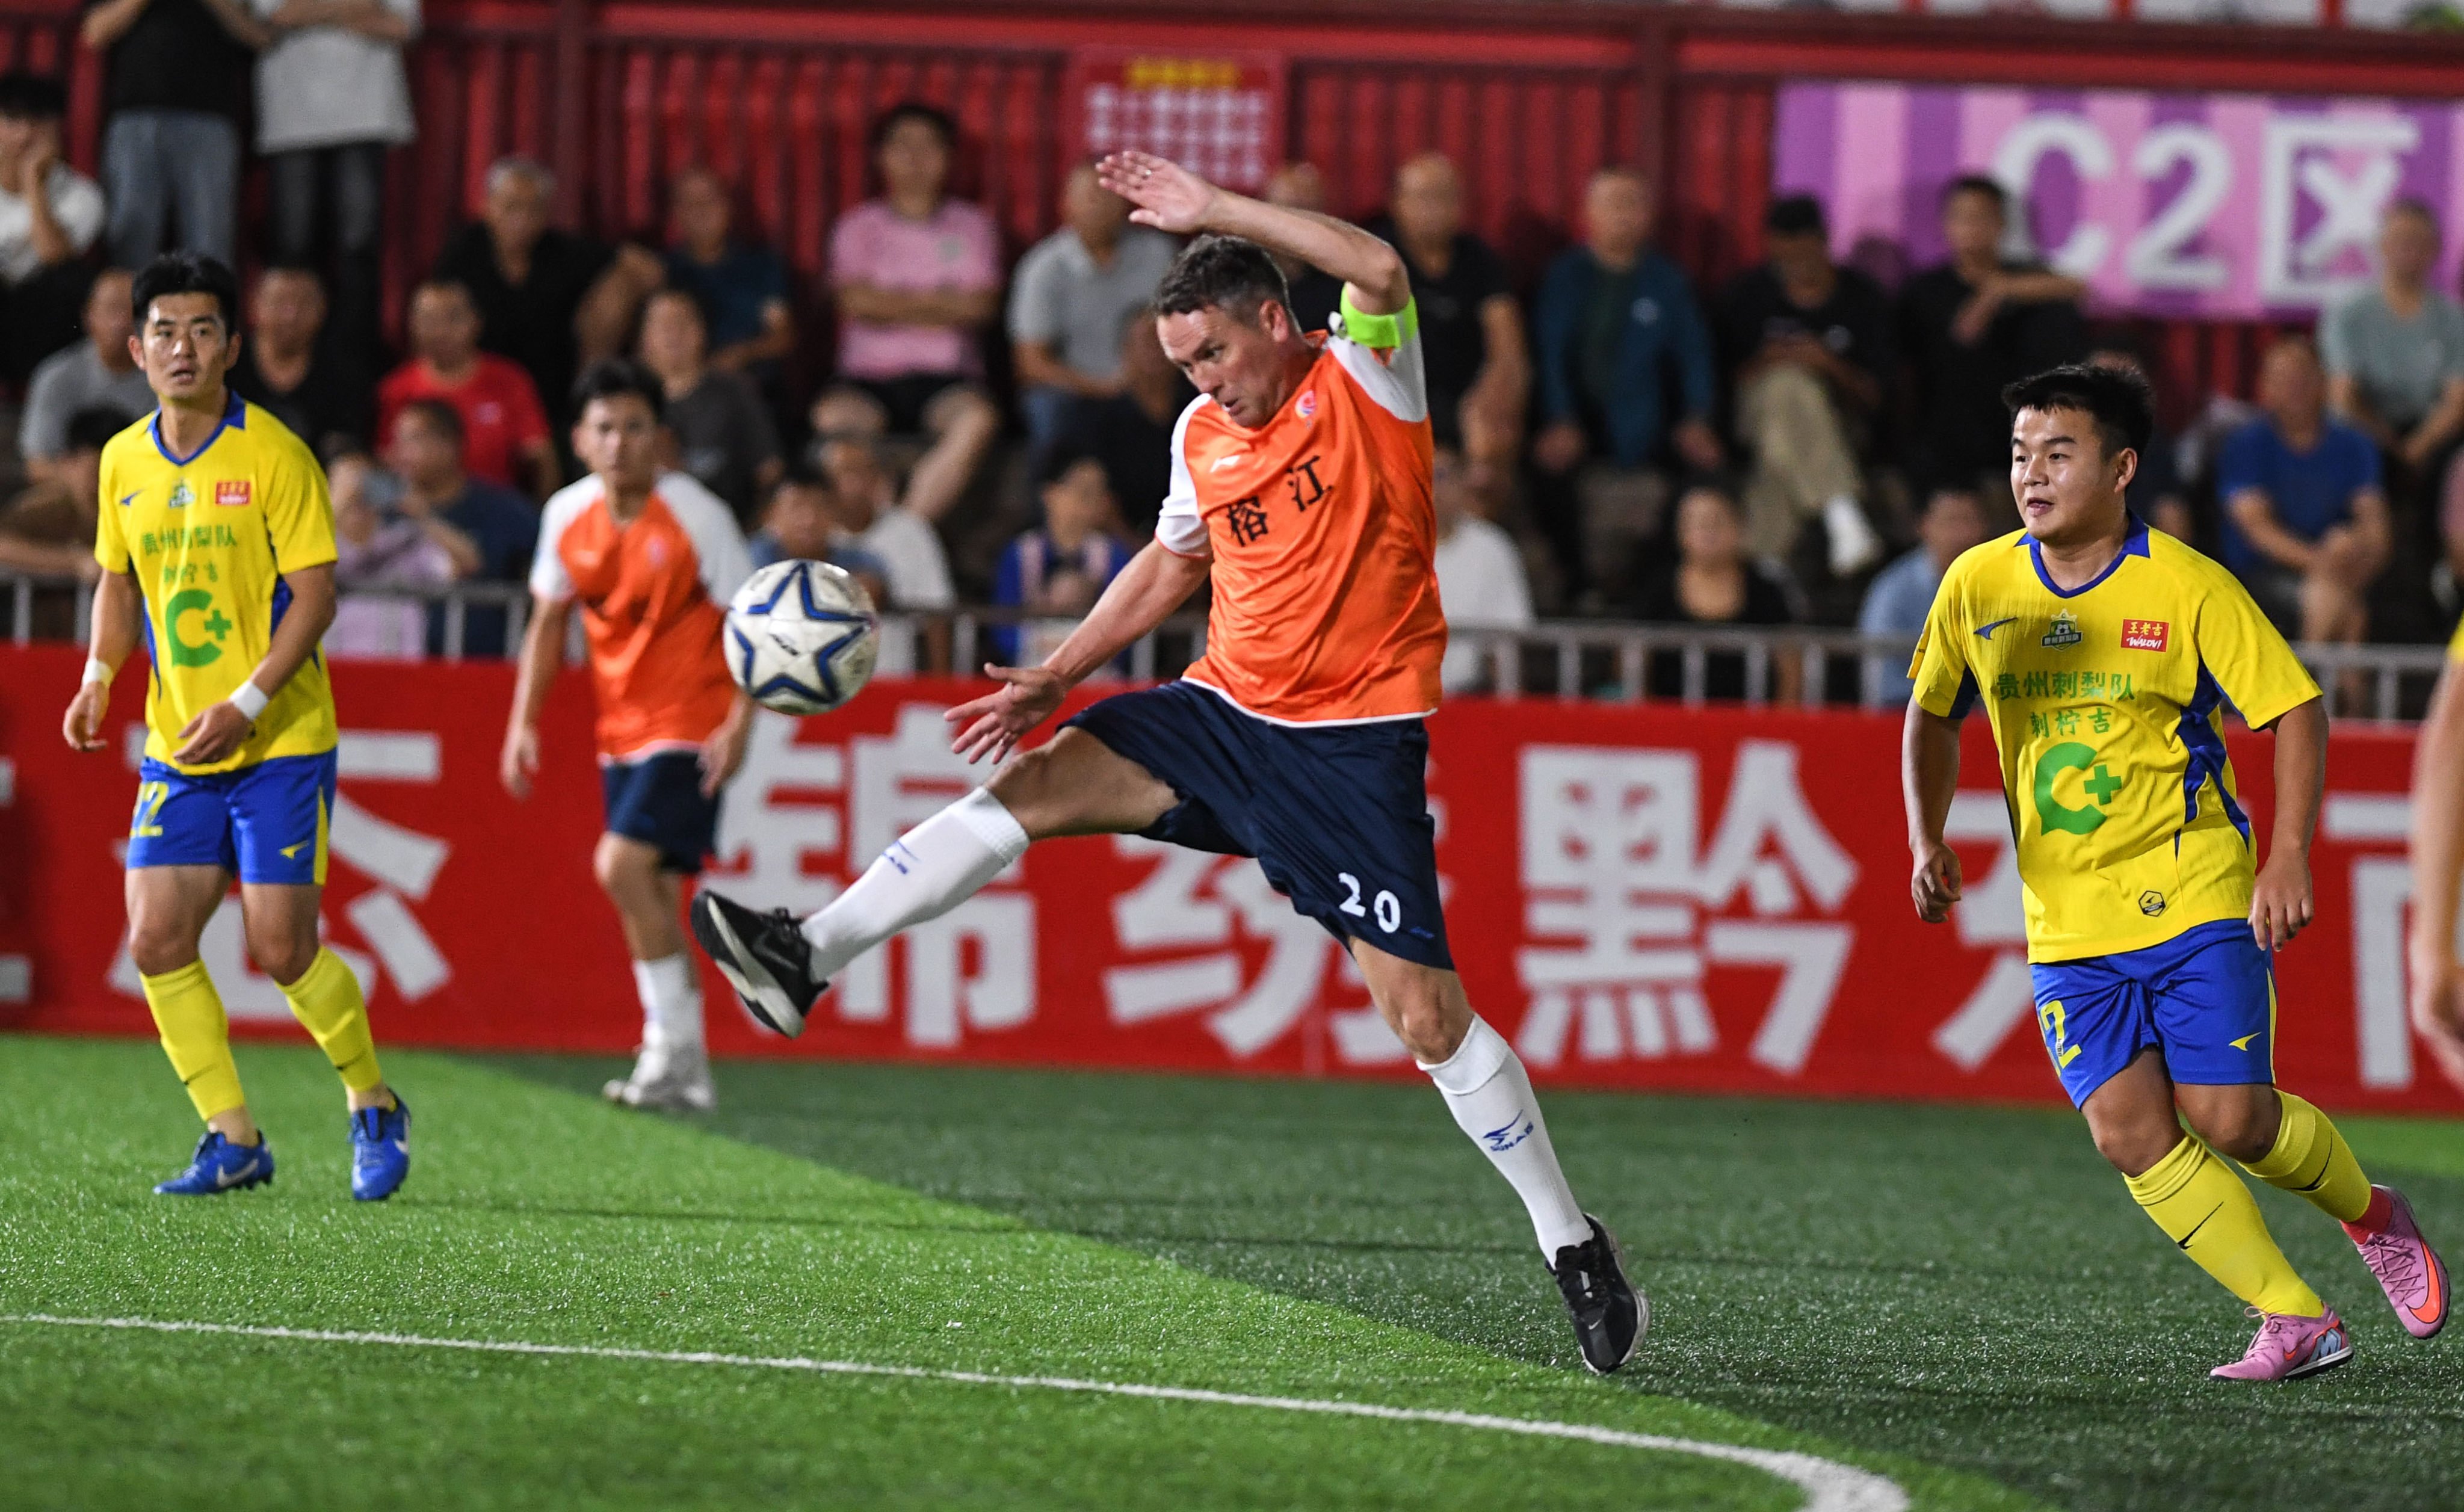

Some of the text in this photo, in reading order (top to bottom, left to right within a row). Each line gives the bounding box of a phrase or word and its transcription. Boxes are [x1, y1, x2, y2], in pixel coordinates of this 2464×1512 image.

[1996, 116, 2419, 304] C2区
[1227, 455, 1333, 547] 榕江
[2126, 634, 2163, 649] WALOVI
[2128, 622, 2163, 637] 王老吉
[1996, 671, 2135, 700] 贵州刺梨队
[2030, 708, 2111, 738] 刺柠吉
[1338, 872, 1401, 933] 20
